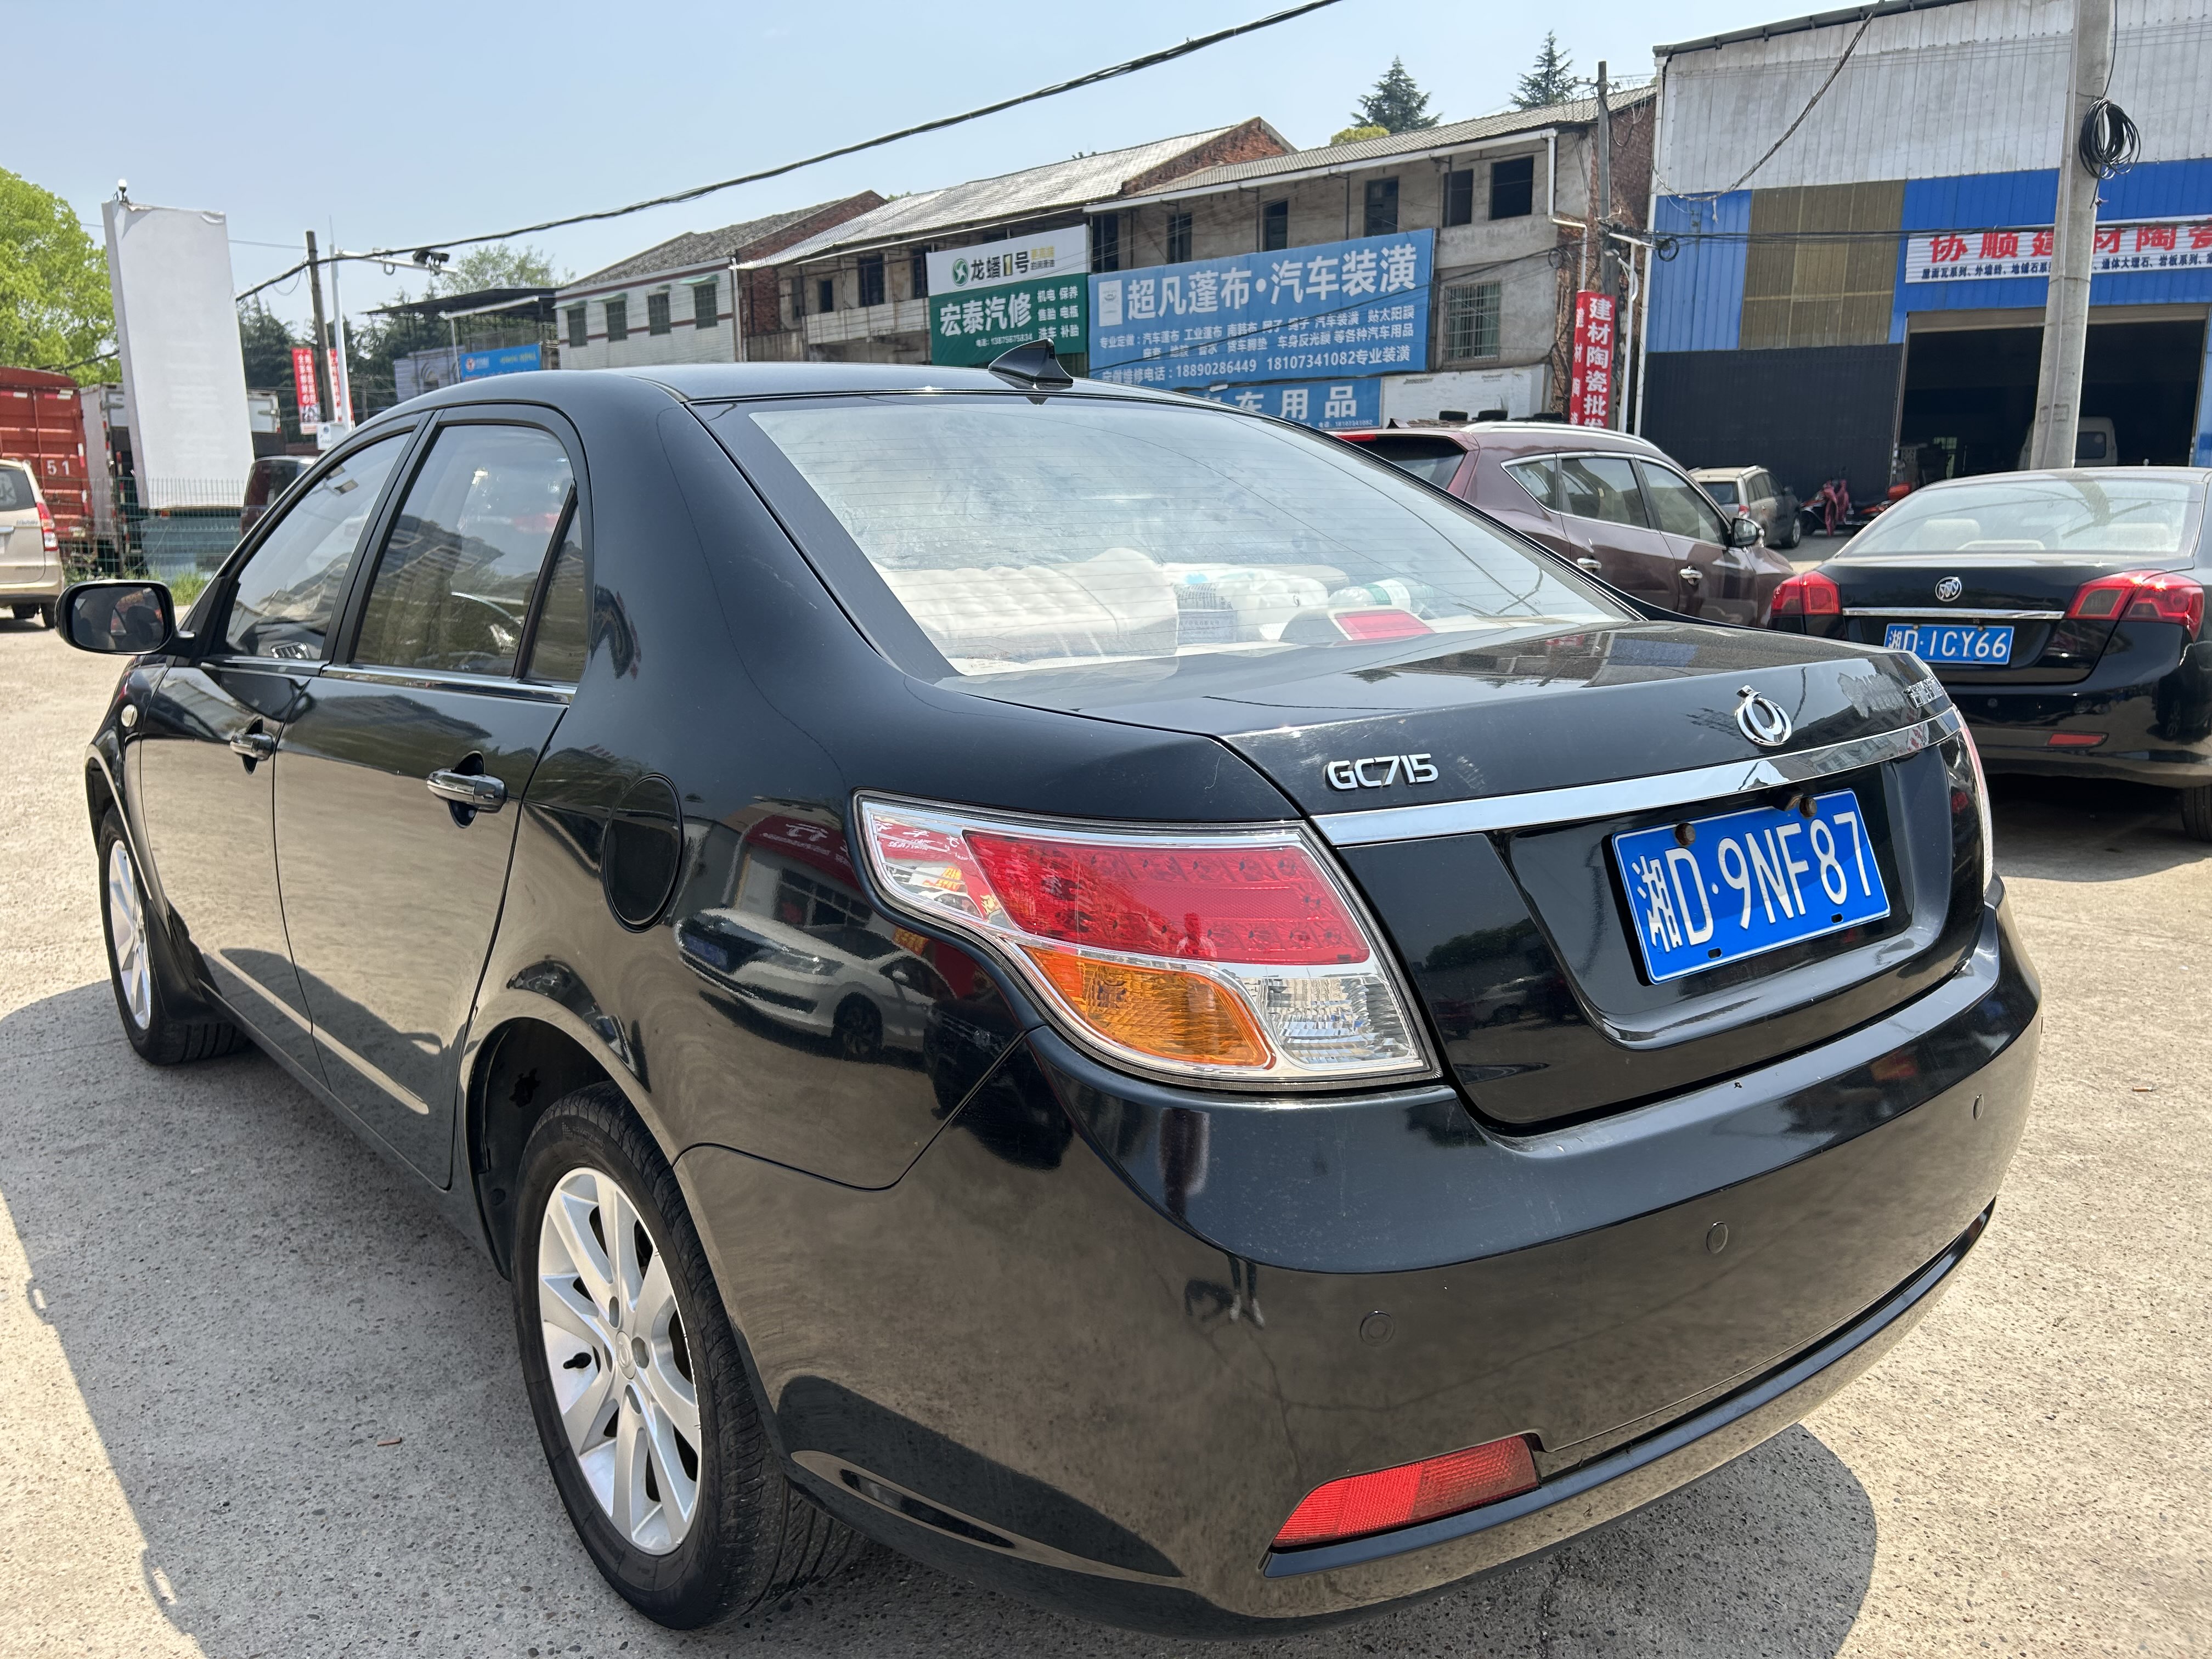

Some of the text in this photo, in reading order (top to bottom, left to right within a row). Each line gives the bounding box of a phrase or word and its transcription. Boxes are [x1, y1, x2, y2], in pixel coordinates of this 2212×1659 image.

[1037, 285, 1079, 303] 机电 保养
[940, 292, 1032, 337] 宏泰汽修
[1059, 305, 1079, 319] 电瓶
[1315, 310, 1359, 329] 汽车装潢
[1368, 304, 1414, 324] 贴太阳膜
[1060, 324, 1080, 338] 补胎
[1204, 385, 1357, 420] 车用品
[1325, 753, 1439, 791] GC715
[1632, 811, 1871, 953] 湘D·9NF87
